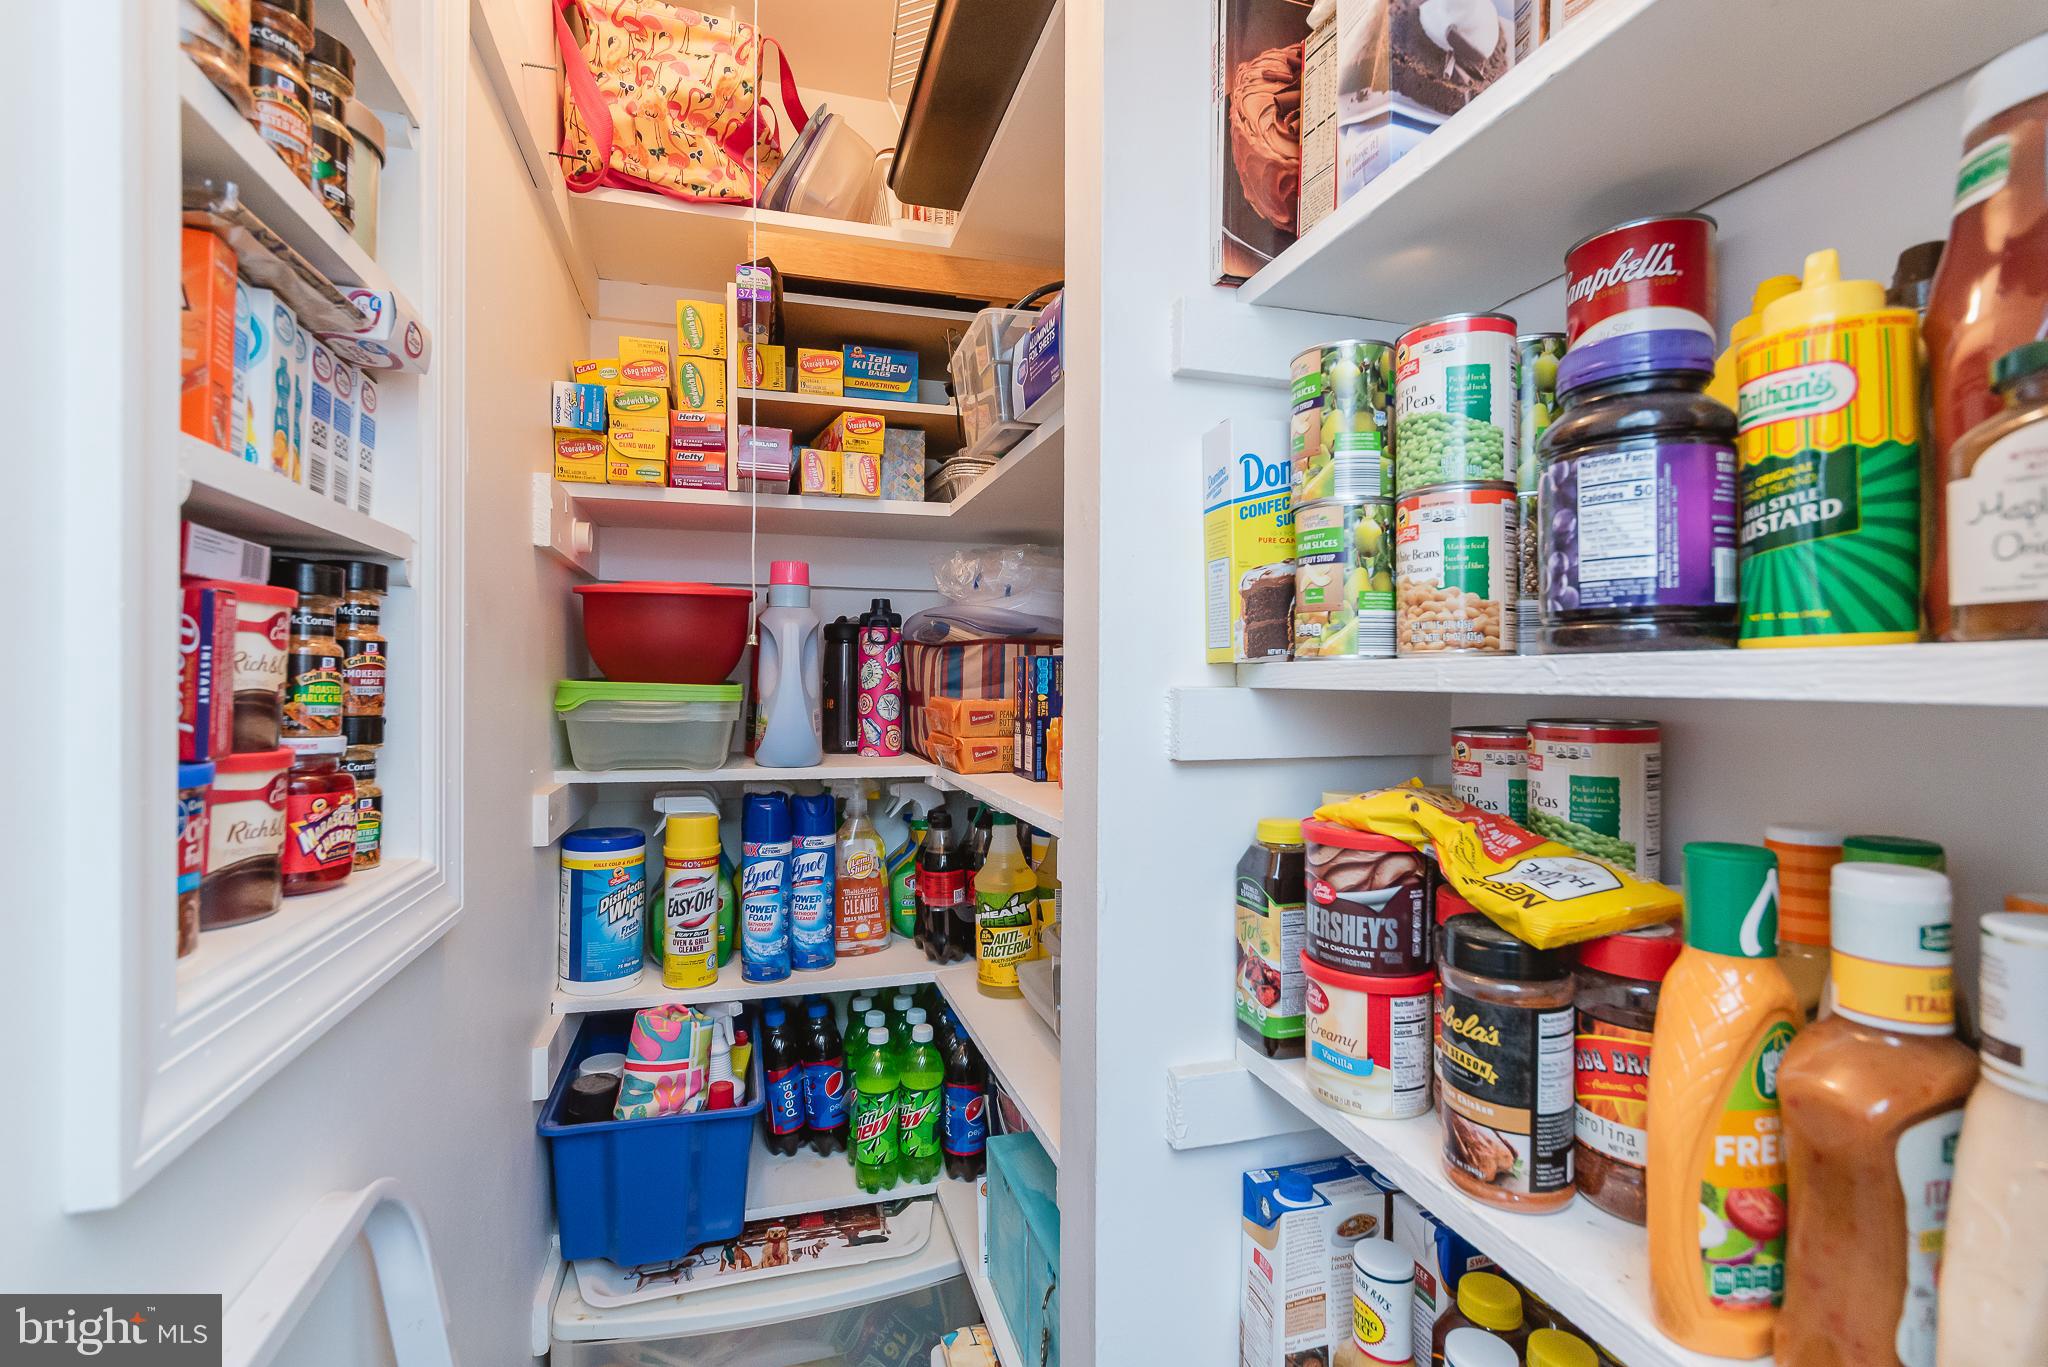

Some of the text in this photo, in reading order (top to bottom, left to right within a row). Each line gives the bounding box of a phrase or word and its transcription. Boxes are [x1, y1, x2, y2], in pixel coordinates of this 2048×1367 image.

[1567, 242, 1676, 307] ampbell's
[1029, 315, 1056, 352] ALUMINUM
[1028, 328, 1056, 361] FOIL SHEETS
[802, 358, 840, 369] Storage Bags
[868, 353, 891, 364] Tall
[576, 363, 596, 373] GLAD
[852, 360, 908, 374] KITCHEN
[868, 370, 891, 378] BAGS
[854, 380, 900, 390] DRAWSTRING
[616, 395, 660, 406] Sandwich Bags
[1406, 393, 1436, 411] Peas
[678, 413, 704, 421] Hefty
[848, 419, 881, 429] Storage Bags
[561, 443, 603, 453] Storage Bags
[637, 442, 656, 450] WRAP
[748, 440, 779, 448] KRKLAND
[677, 453, 703, 461] Hefty
[1580, 455, 1622, 469] Nutrition
[611, 467, 628, 476] 400
[675, 478, 683, 486] 15
[1580, 485, 1653, 504] Calories 50
[1769, 487, 1819, 512] STYLE
[1258, 536, 1277, 544] PURE
[1311, 539, 1338, 549] SLICES
[1316, 554, 1336, 562] SYRUP
[1411, 550, 1440, 561] Beans
[308, 685, 341, 693] ROASTED
[294, 694, 327, 702] GARLIC
[1452, 778, 1480, 794] Green
[1572, 784, 1615, 793] Picked fresh
[1468, 793, 1499, 811] Peas
[1531, 789, 1558, 808] Peas
[1572, 795, 1616, 804] Packed fresh
[1486, 823, 1522, 848] MINI
[682, 860, 701, 868] 40%
[743, 861, 781, 890] Lysol
[667, 887, 715, 917] EASY-OFF
[792, 894, 823, 903] POWER
[745, 904, 778, 914] POWER
[844, 896, 879, 915] CLEANER
[982, 903, 1027, 919] MEAN
[621, 919, 639, 933] Fresh
[1306, 902, 1398, 950] HERSHEY'S
[694, 937, 710, 945] GRILL
[993, 930, 1023, 945] ANTI-
[678, 945, 704, 953] CLEANER
[982, 937, 1032, 957] BACTERIAL
[1316, 939, 1375, 958] MILK CHOCOLATE
[1341, 958, 1371, 969] FROSTING
[1394, 1000, 1414, 1008] Nutrition
[1310, 1016, 1358, 1053] Creamy
[1321, 1048, 1353, 1071] Vanilla
[1451, 1046, 1487, 1074] SEASON
[778, 1079, 797, 1118] pepsi
[1576, 1110, 1635, 1147] arolina
[1608, 1143, 1625, 1153] NET
